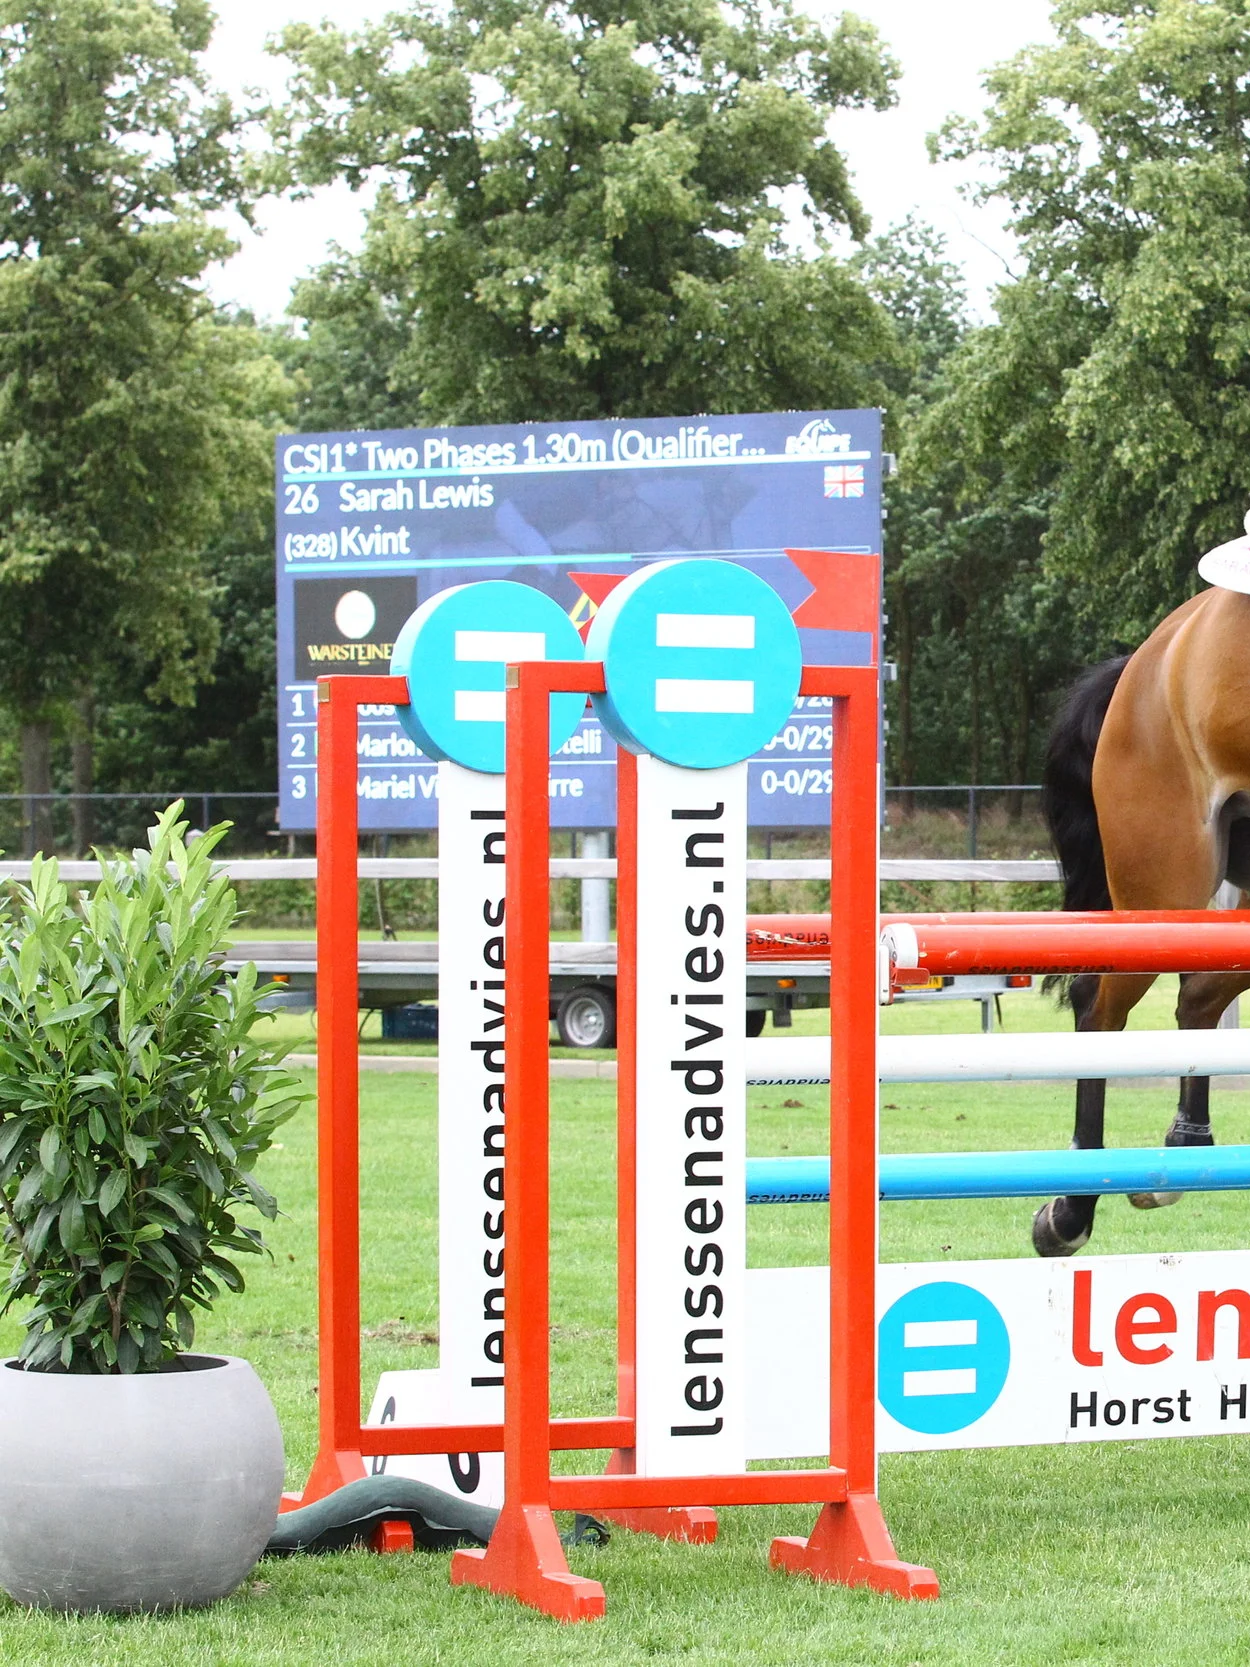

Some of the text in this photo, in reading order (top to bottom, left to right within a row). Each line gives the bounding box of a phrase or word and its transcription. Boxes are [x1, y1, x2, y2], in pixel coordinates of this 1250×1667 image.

[362, 440, 418, 471] Two
[423, 437, 516, 469] Phases
[523, 433, 606, 465] 1.30m
[284, 476, 494, 514] 26 Sarah Lewis
[284, 524, 411, 562] (328) Kvint
[307, 642, 396, 661] WARSTEINE
[291, 692, 306, 717] 1
[290, 733, 306, 757] 2
[291, 775, 307, 799] 3
[470, 810, 506, 1387] lenssenadviesnl
[671, 802, 724, 1437] lenssenadvies.nl
[1070, 1389, 1192, 1428] Horst
